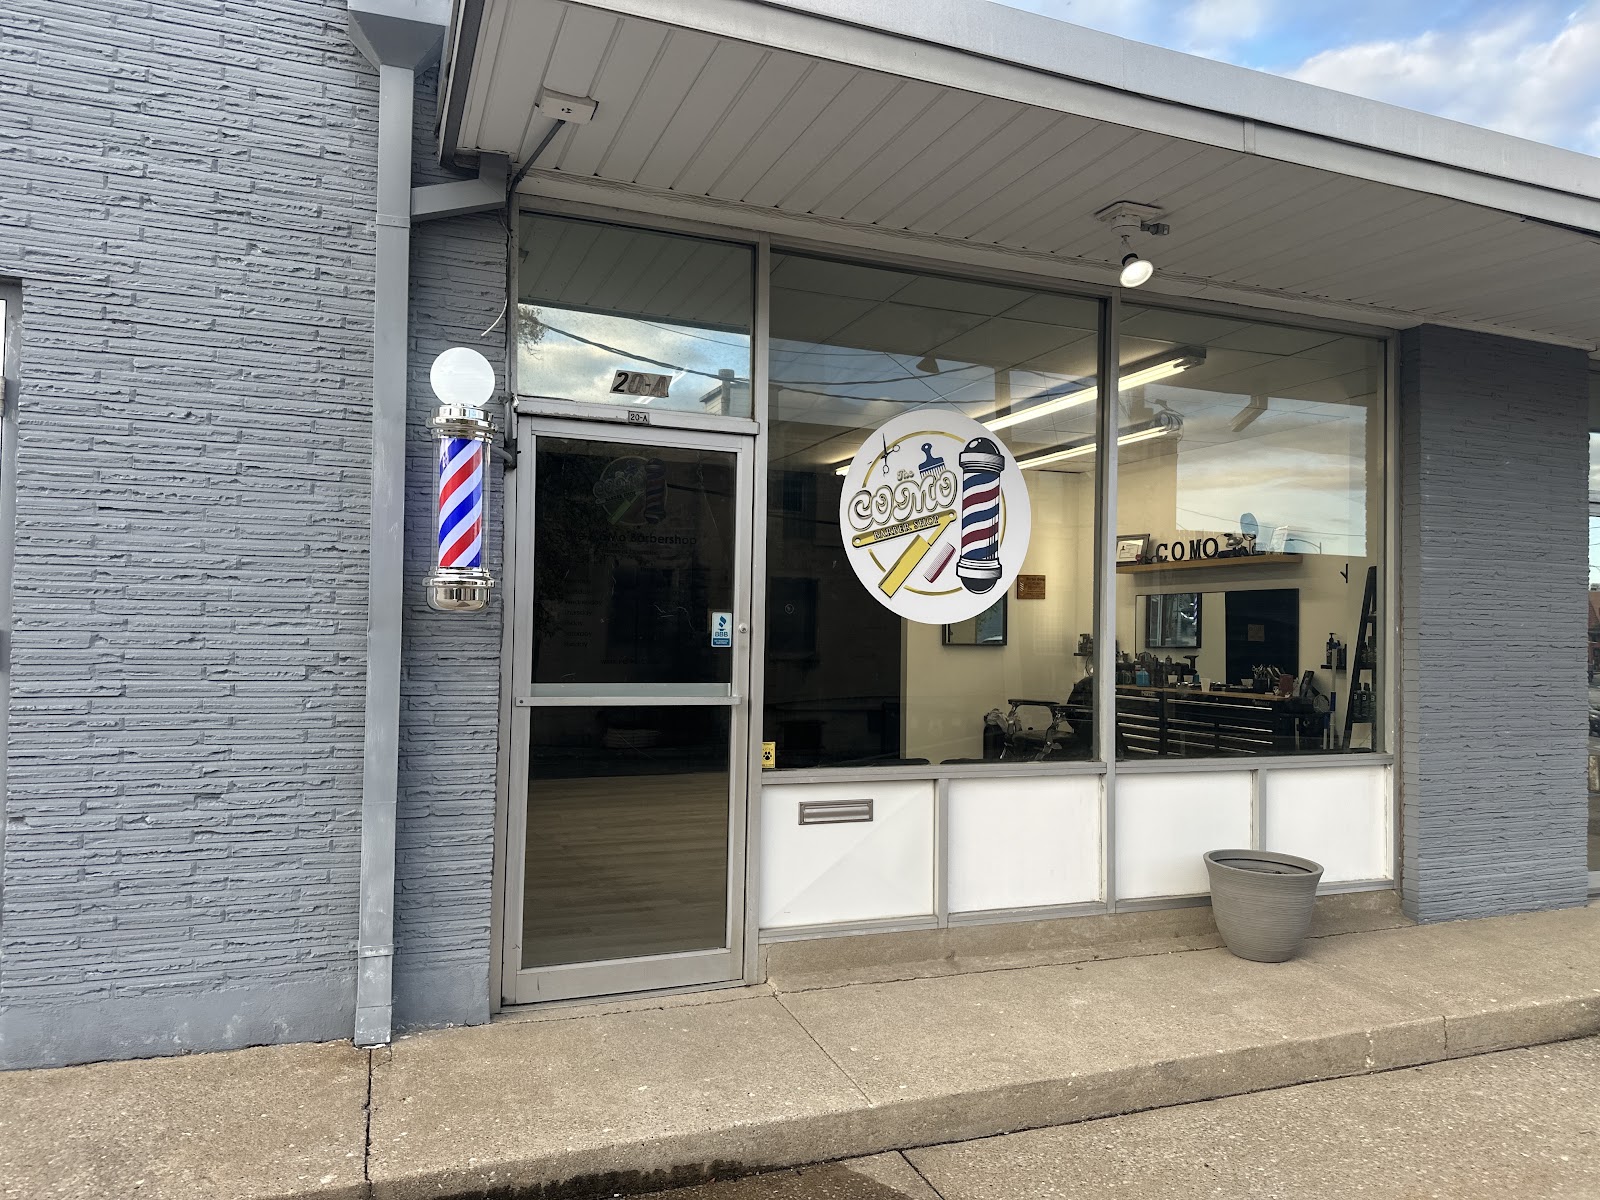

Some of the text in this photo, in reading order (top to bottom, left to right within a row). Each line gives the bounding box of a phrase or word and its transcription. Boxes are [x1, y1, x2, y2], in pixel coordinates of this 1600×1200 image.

[630, 413, 648, 422] 20-A
[896, 469, 915, 481] The
[847, 469, 958, 532] COMO
[873, 514, 941, 541] BARBER SHOP
[630, 532, 697, 546] Barbershop
[1155, 537, 1220, 562] COMO
